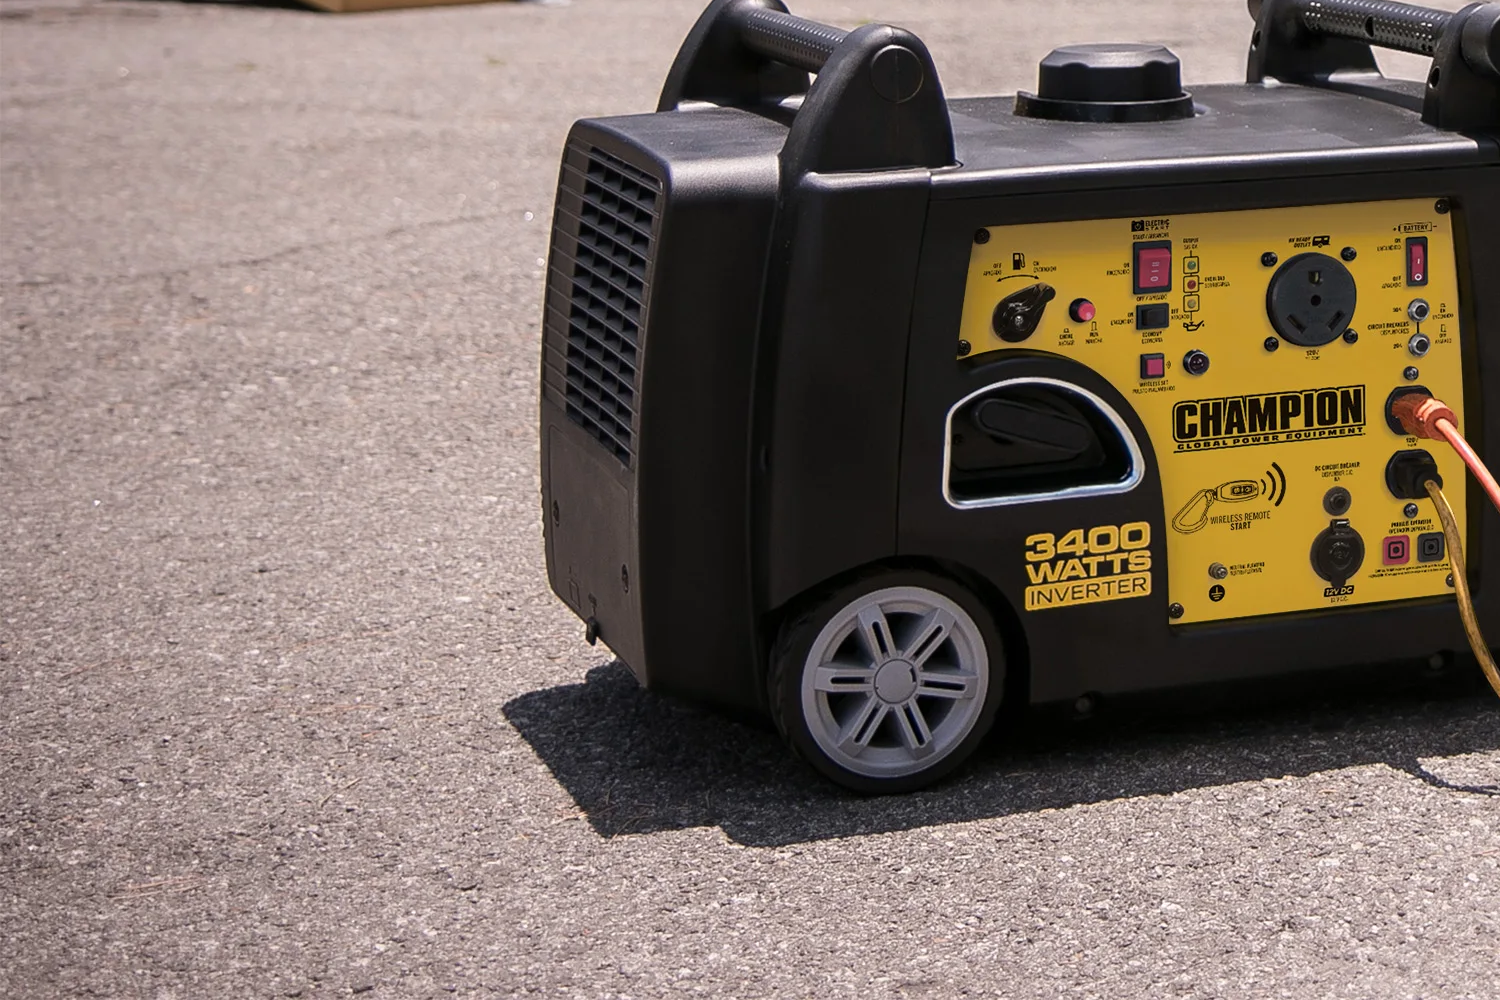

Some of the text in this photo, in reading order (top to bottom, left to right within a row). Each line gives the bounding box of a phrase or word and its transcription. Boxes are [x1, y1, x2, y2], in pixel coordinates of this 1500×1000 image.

[1145, 219, 1170, 227] ELECTRIC
[1174, 388, 1363, 441] CHAMPION
[1177, 427, 1364, 450] GLOBAL POWER EQUIPMENT
[1210, 510, 1271, 524] WIRELESS REMOTE
[1230, 521, 1251, 530] START
[1025, 521, 1150, 561] 3400
[1026, 550, 1151, 584] WATTS
[1031, 577, 1147, 605] INVERTER
[1326, 586, 1353, 596] 12V DC
